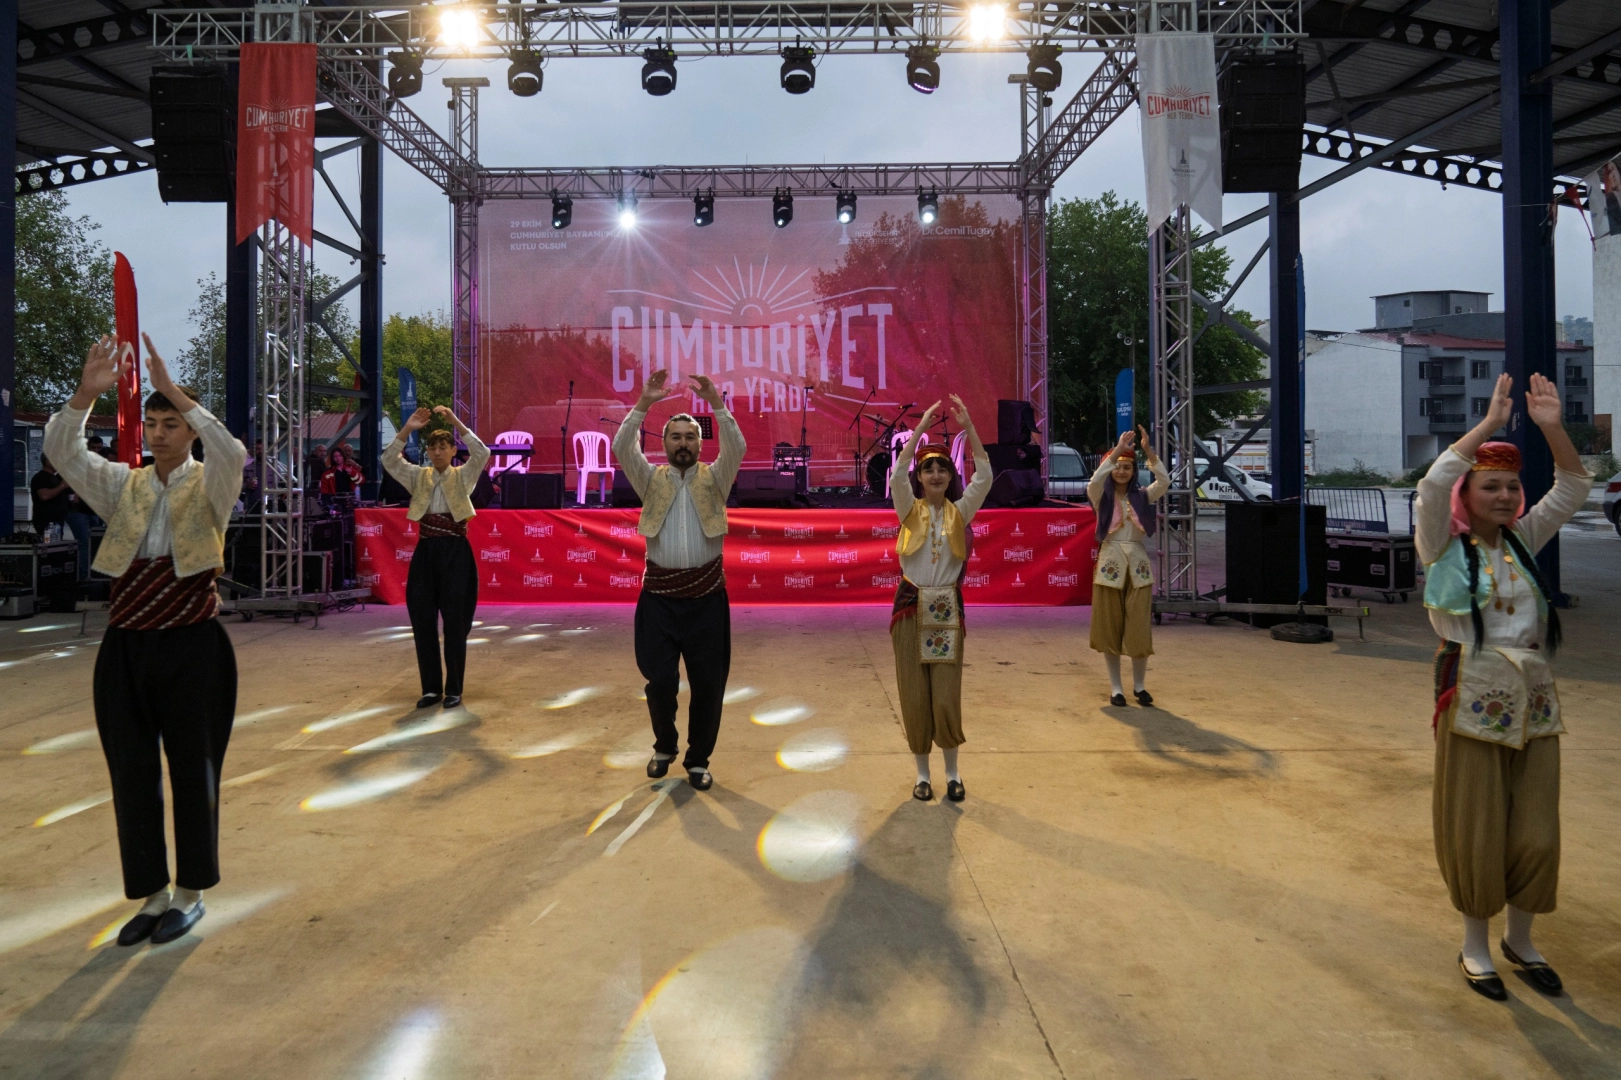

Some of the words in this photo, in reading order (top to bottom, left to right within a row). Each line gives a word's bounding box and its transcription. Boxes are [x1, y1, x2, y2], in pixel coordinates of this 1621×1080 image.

[1147, 96, 1210, 116] CUMHURİYET
[246, 107, 308, 128] CUMHURİYET
[522, 220, 542, 228] EKİM
[510, 230, 565, 239] CUMHURİYET
[538, 242, 566, 250] OLSUN
[612, 303, 893, 392] CUMHURİYET
[744, 376, 816, 413] YERDE
